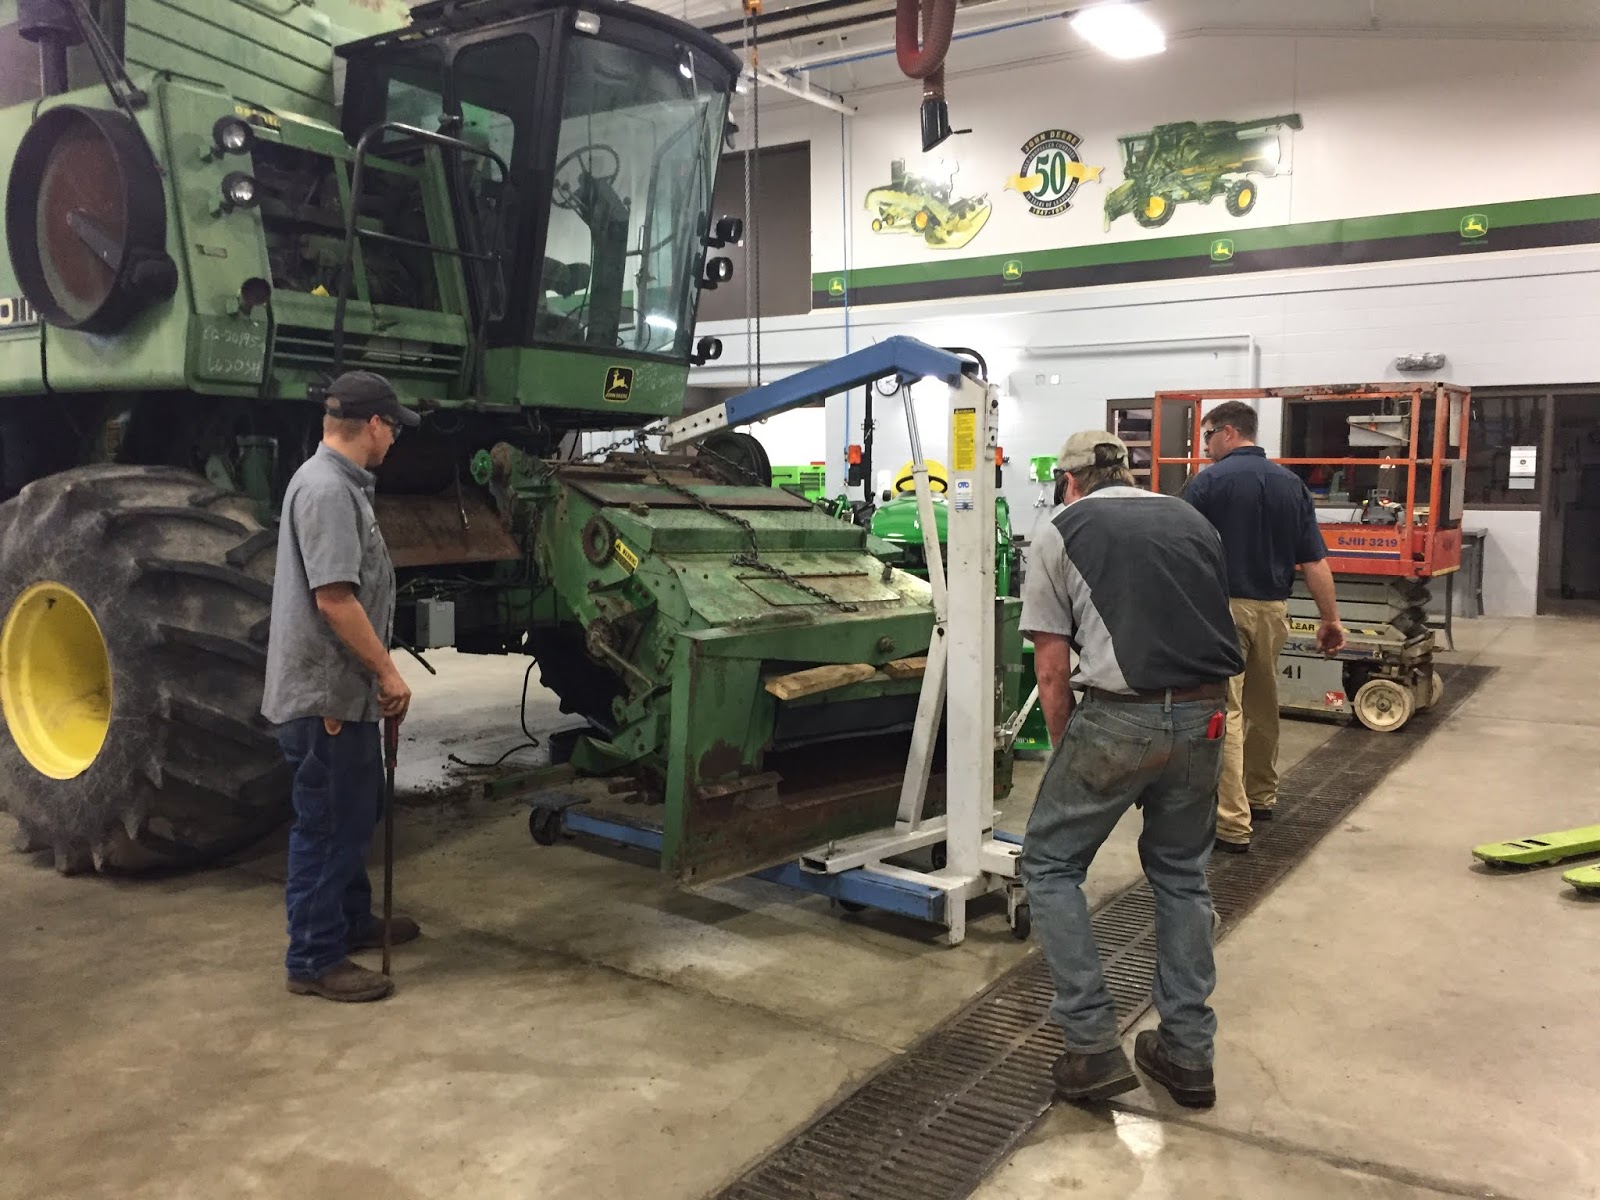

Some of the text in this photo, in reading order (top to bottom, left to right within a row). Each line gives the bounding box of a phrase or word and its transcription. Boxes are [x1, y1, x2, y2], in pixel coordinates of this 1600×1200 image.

[1025, 131, 1078, 152] JOHN DEERE
[1034, 151, 1067, 198] 50
[1369, 538, 1398, 547] 3219
[1289, 622, 1315, 631] LEAR
[1282, 665, 1301, 679] 41
